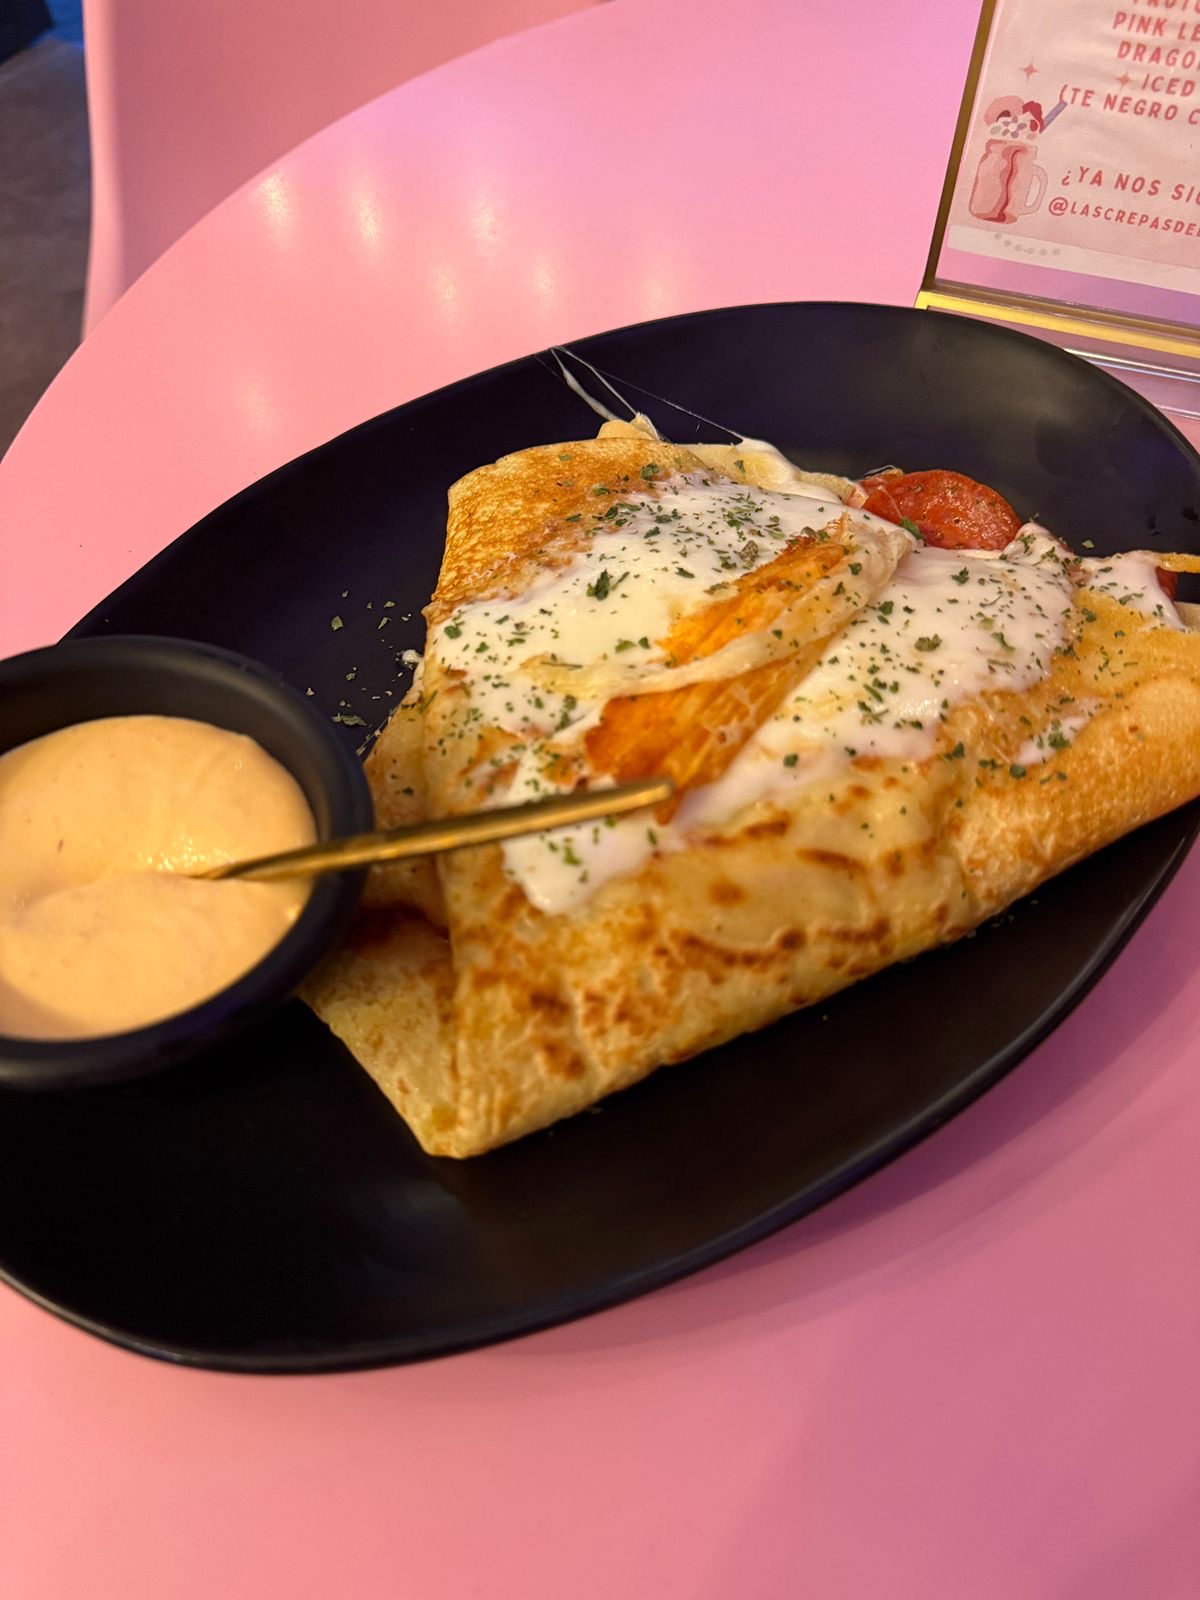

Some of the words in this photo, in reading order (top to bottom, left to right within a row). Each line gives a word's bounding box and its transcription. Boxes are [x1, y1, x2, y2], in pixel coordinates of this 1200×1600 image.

[1112, 11, 1168, 37] PINK
[1117, 40, 1200, 71] DRAGO
[1142, 73, 1196, 97] ICED
[1059, 84, 1095, 107] (TE
[1103, 93, 1178, 121] NEGRO
[1061, 166, 1103, 187] ¿YA
[1114, 173, 1161, 196] NOS
